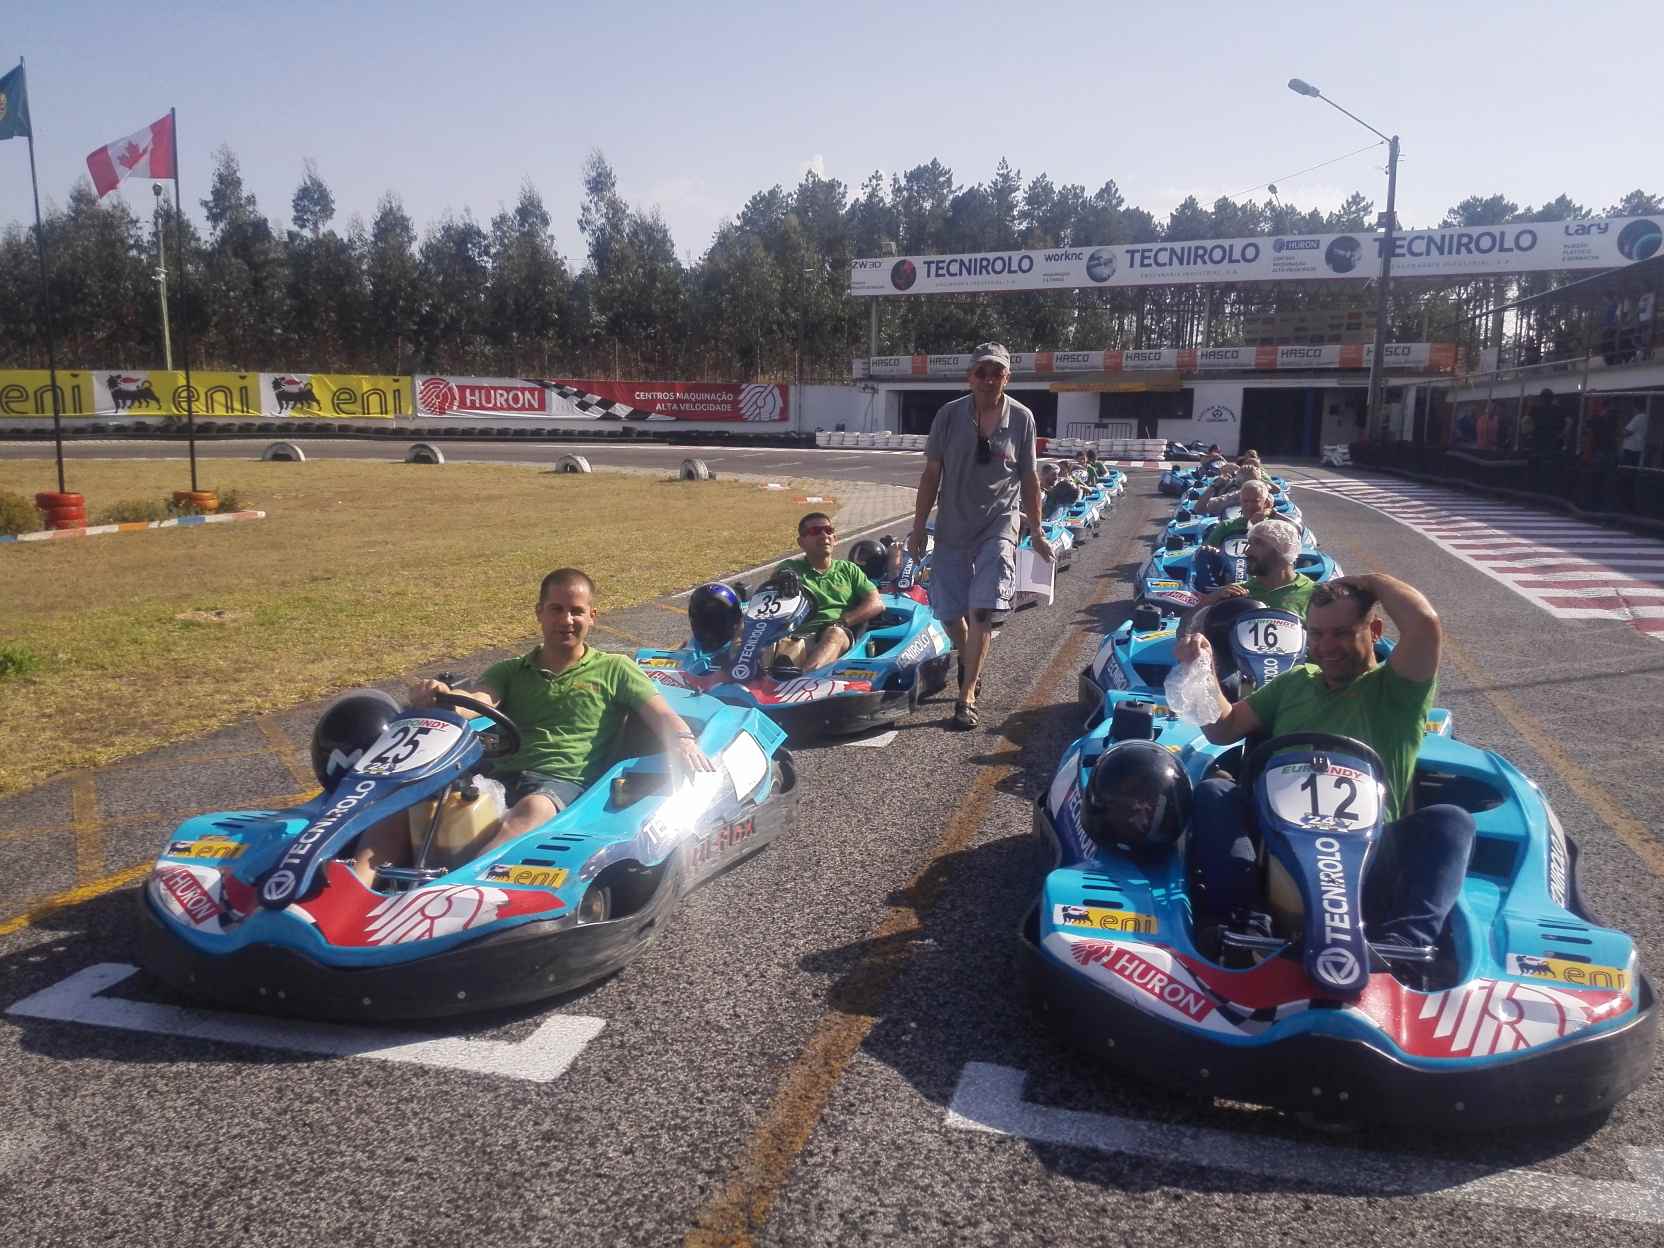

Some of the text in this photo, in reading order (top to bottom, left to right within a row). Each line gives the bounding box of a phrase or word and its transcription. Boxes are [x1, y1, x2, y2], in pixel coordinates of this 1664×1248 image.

[1373, 229, 1538, 258] TECNIROLO
[923, 255, 1034, 278] TECNIROLO
[1044, 250, 1084, 263] worknc
[1125, 242, 1260, 269] TECNIROLO
[872, 358, 900, 367] HASCO
[929, 357, 959, 366] HASCO
[1056, 354, 1090, 363] HASCO
[1126, 352, 1161, 361] HASCO
[1200, 350, 1239, 360] HASCO
[1280, 348, 1322, 358] HASCO
[1366, 346, 1411, 356] HSCO
[0, 373, 82, 414] eni
[172, 375, 249, 415] eni
[331, 378, 401, 415] eni
[465, 387, 539, 410] HURON
[634, 391, 675, 400] CENTROS
[656, 403, 732, 411] ALTA VELOCIDADE
[757, 595, 781, 614] 35
[1249, 623, 1278, 647] 16
[370, 727, 432, 764] 25
[1301, 773, 1359, 821] 12
[279, 780, 376, 868] TECNIROLO
[513, 868, 564, 888] eni
[168, 876, 217, 919] HURON
[1315, 838, 1350, 943] TECNIROLO
[1100, 913, 1155, 933] eni
[1113, 952, 1206, 1016] HURON
[1563, 967, 1625, 990] eni
